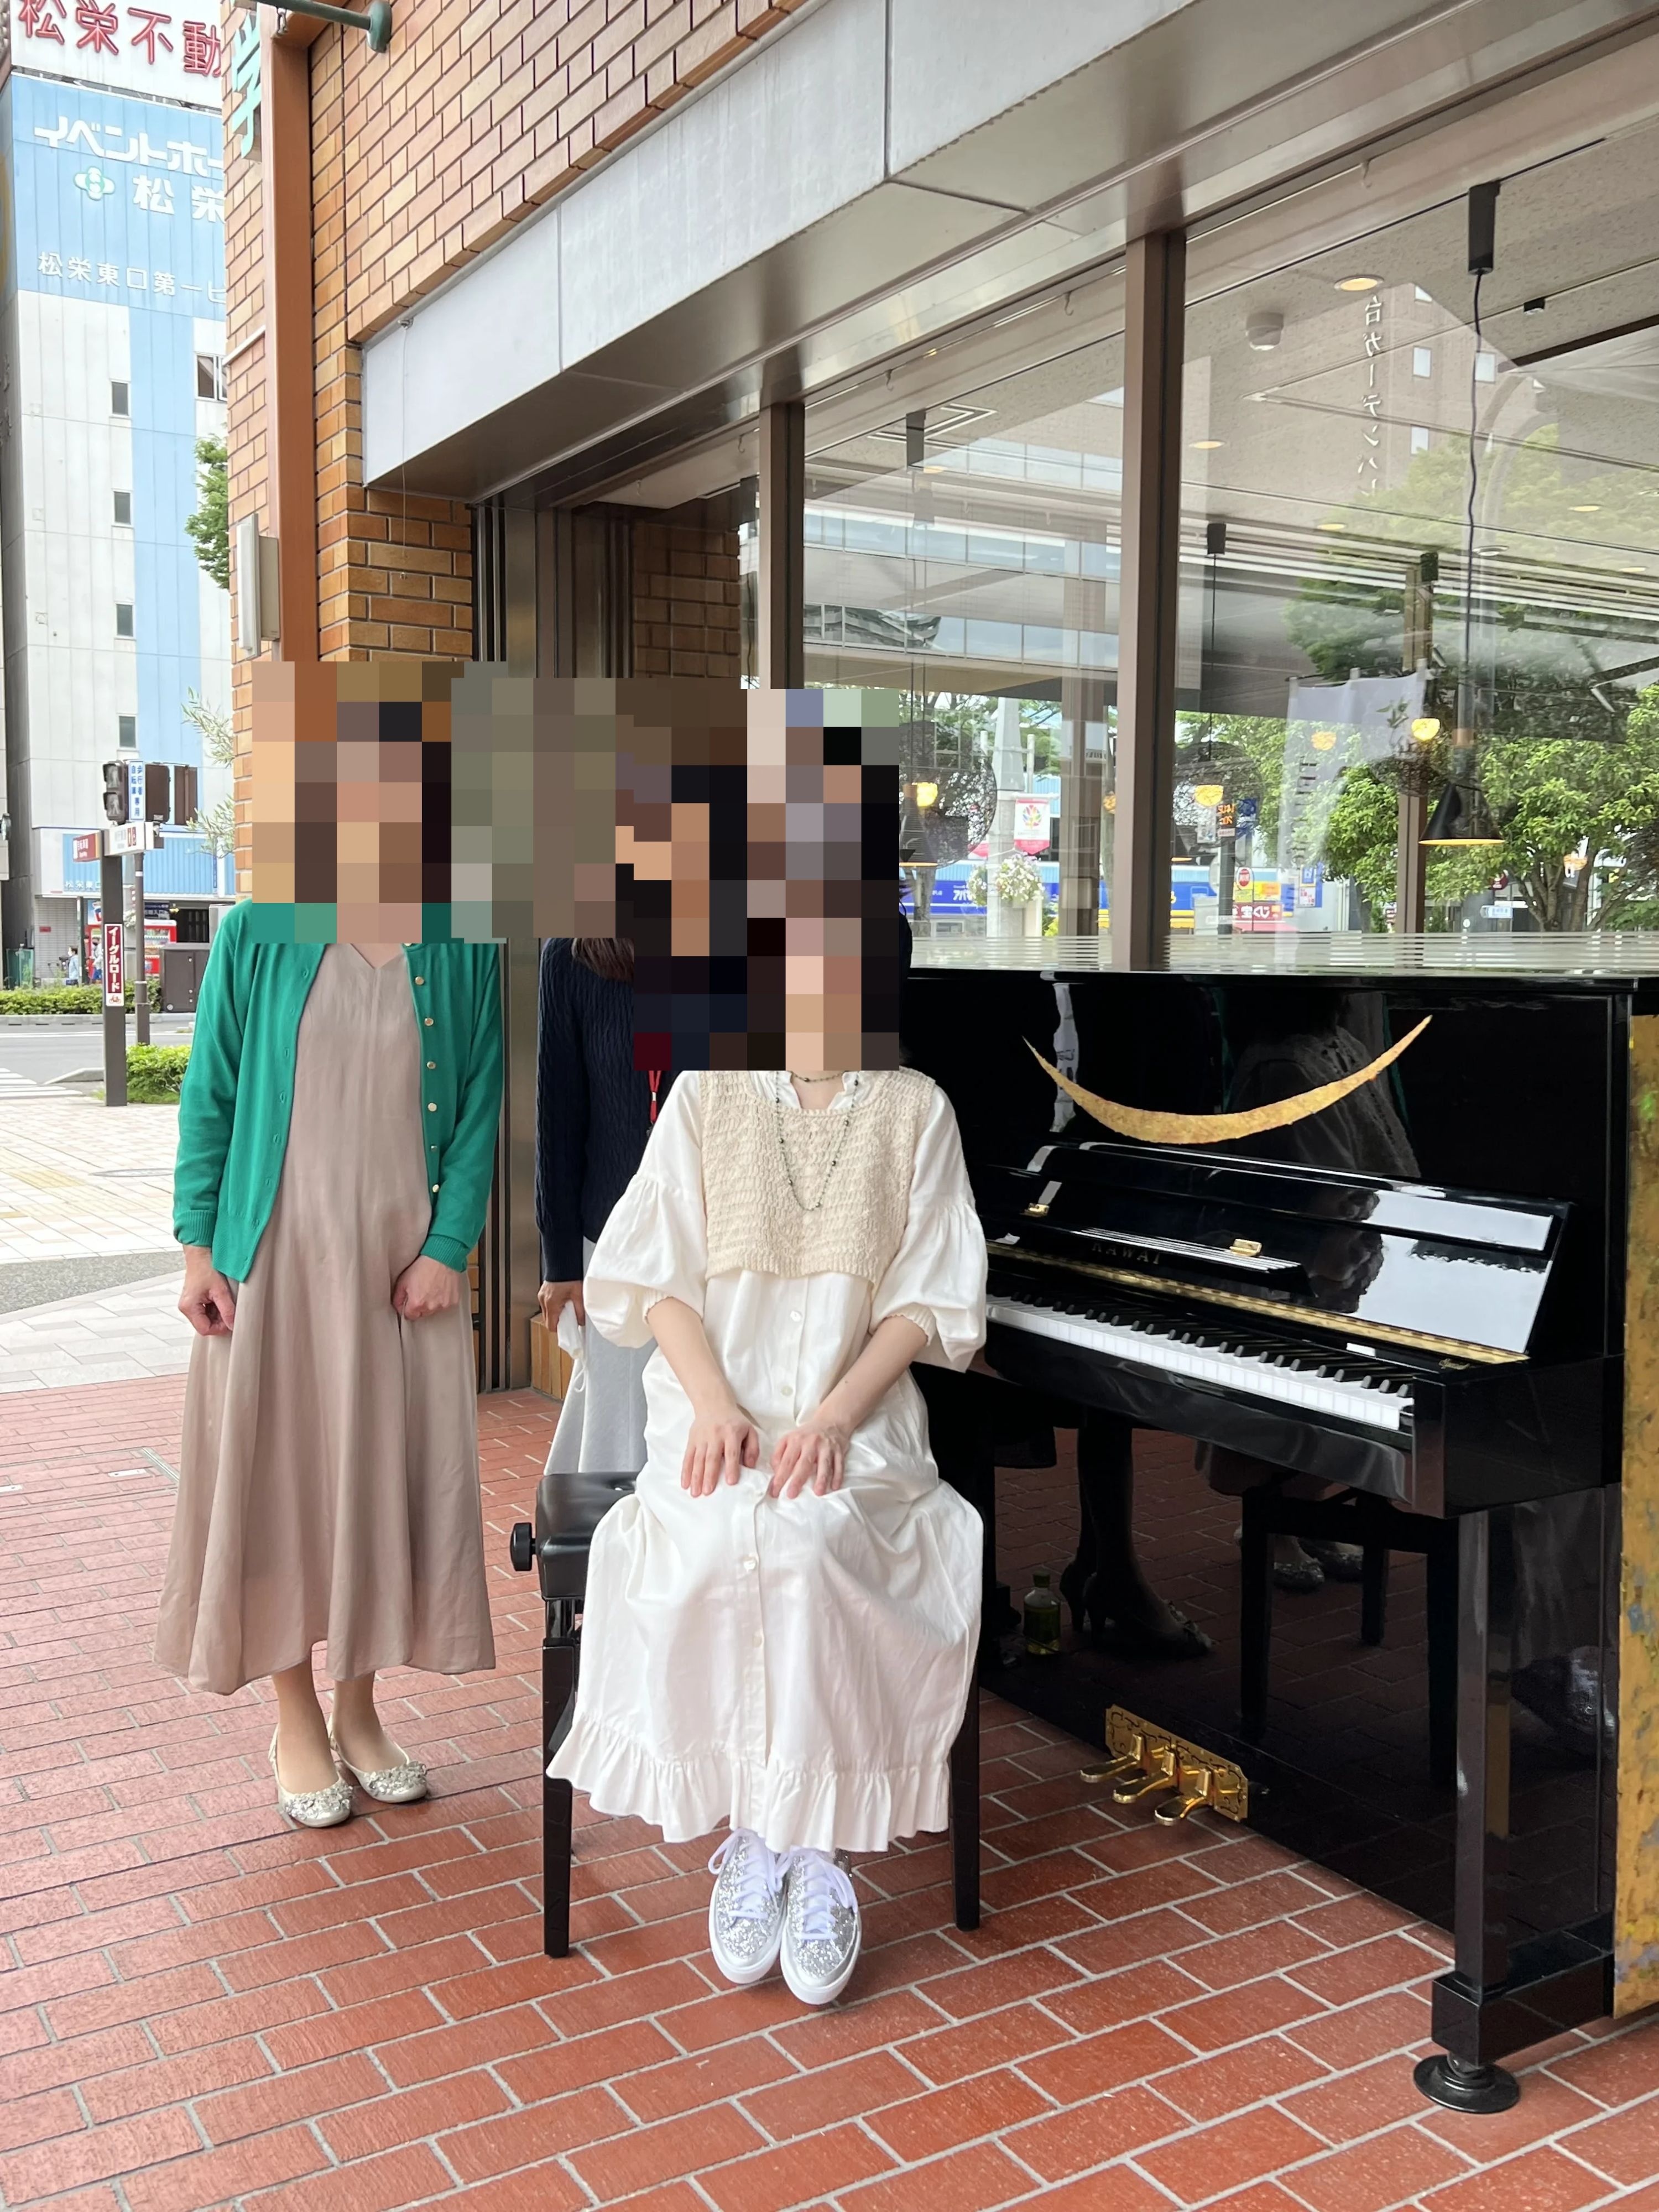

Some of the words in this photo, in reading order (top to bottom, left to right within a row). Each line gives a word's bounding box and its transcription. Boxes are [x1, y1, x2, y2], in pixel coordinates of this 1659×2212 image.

[19, 0, 221, 77] 松栄不動
[108, 926, 121, 993] イーグルロード
